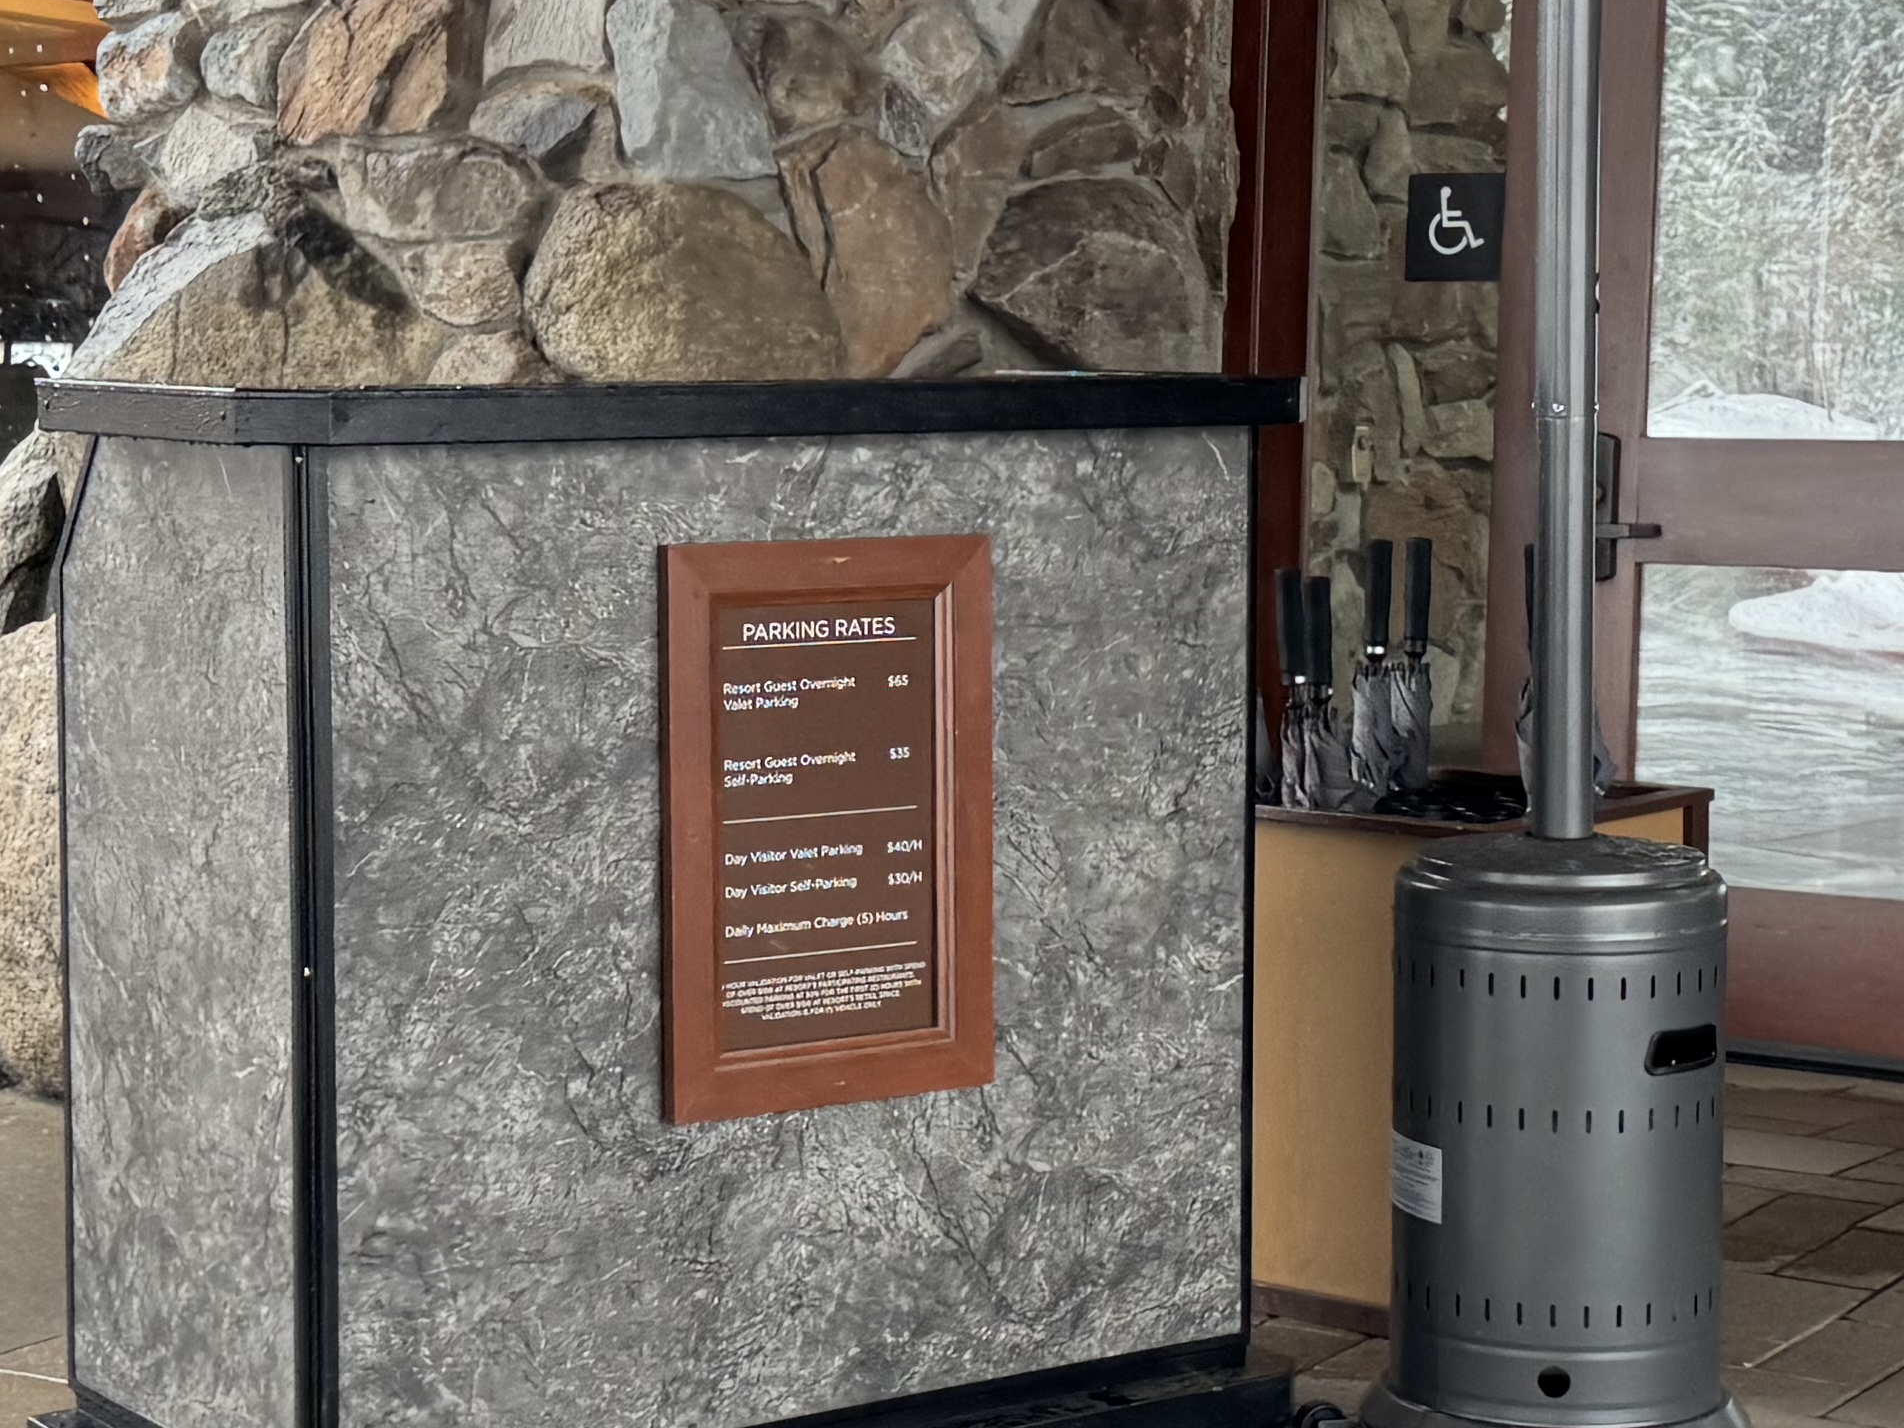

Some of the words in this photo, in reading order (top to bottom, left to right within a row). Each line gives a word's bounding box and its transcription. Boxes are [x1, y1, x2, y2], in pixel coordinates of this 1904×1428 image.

[742, 620, 829, 641] PARKING
[835, 616, 896, 637] RATES
[723, 682, 761, 696] Resort
[763, 679, 797, 693] Guest
[799, 675, 856, 691] Overnight
[887, 674, 909, 688] $65
[723, 699, 753, 712] Valet
[755, 695, 799, 710] Parking
[723, 759, 761, 772] Resort
[764, 756, 798, 769] Guest
[800, 750, 856, 767] Overnight
[889, 747, 910, 760] $35
[724, 772, 794, 789] Self-Parking
[725, 853, 747, 867] Day
[750, 849, 787, 863] Visitor
[789, 846, 818, 860] Valet
[820, 843, 864, 858] Parking
[725, 886, 747, 900] Day
[750, 882, 787, 896] Visitor
[790, 876, 858, 893] Self-Parking
[725, 924, 754, 939] Daily
[756, 920, 812, 935] Maximum
[814, 915, 855, 930] Charge
[856, 912, 873, 926] (5)
[876, 909, 909, 923] Hours
